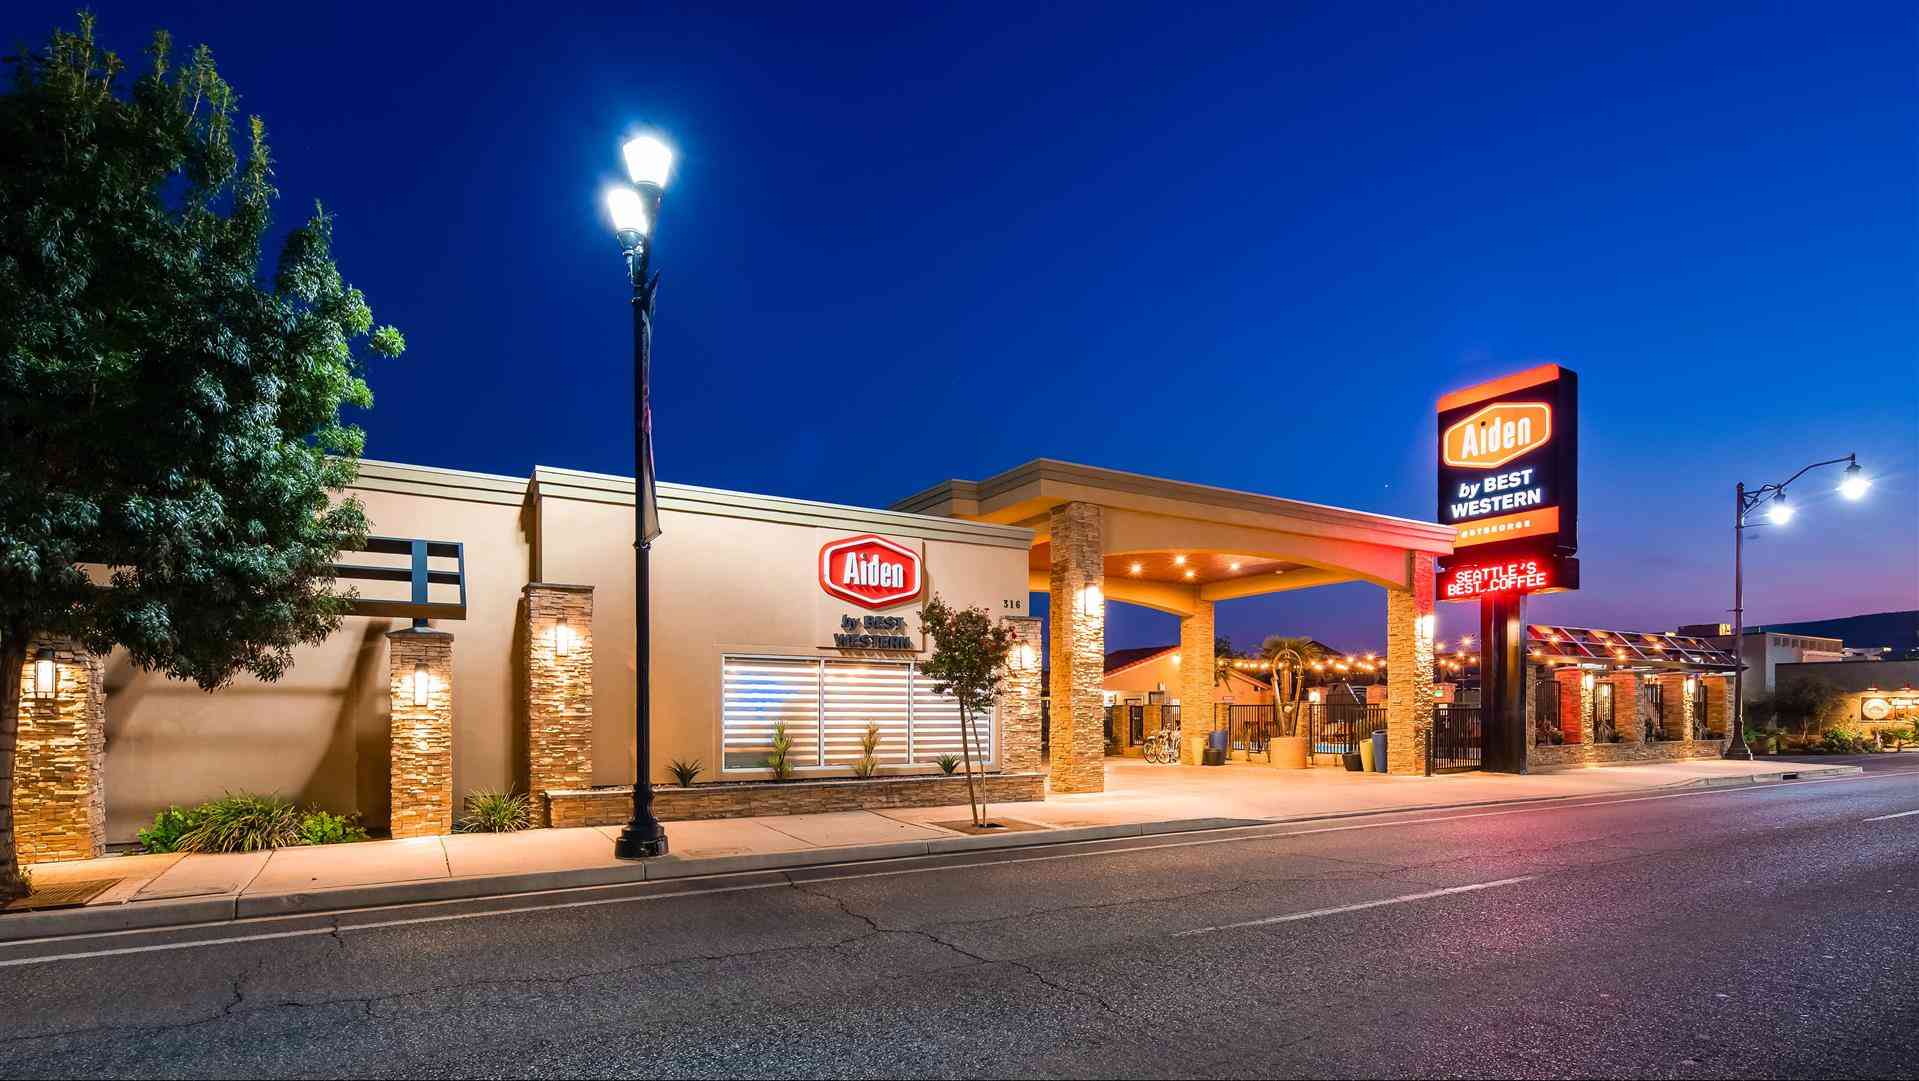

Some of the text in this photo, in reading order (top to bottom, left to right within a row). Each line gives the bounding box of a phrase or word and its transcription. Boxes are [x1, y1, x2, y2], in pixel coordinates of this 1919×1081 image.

[1461, 416, 1532, 459] Aiden
[1459, 469, 1533, 499] by BEST
[1451, 488, 1541, 519] WESTERN
[843, 551, 904, 588] Aiden
[1455, 561, 1537, 584] SEATTLE'S
[1003, 599, 1021, 609] 316
[841, 614, 905, 631] by BEST
[834, 633, 912, 649] WESTERN
